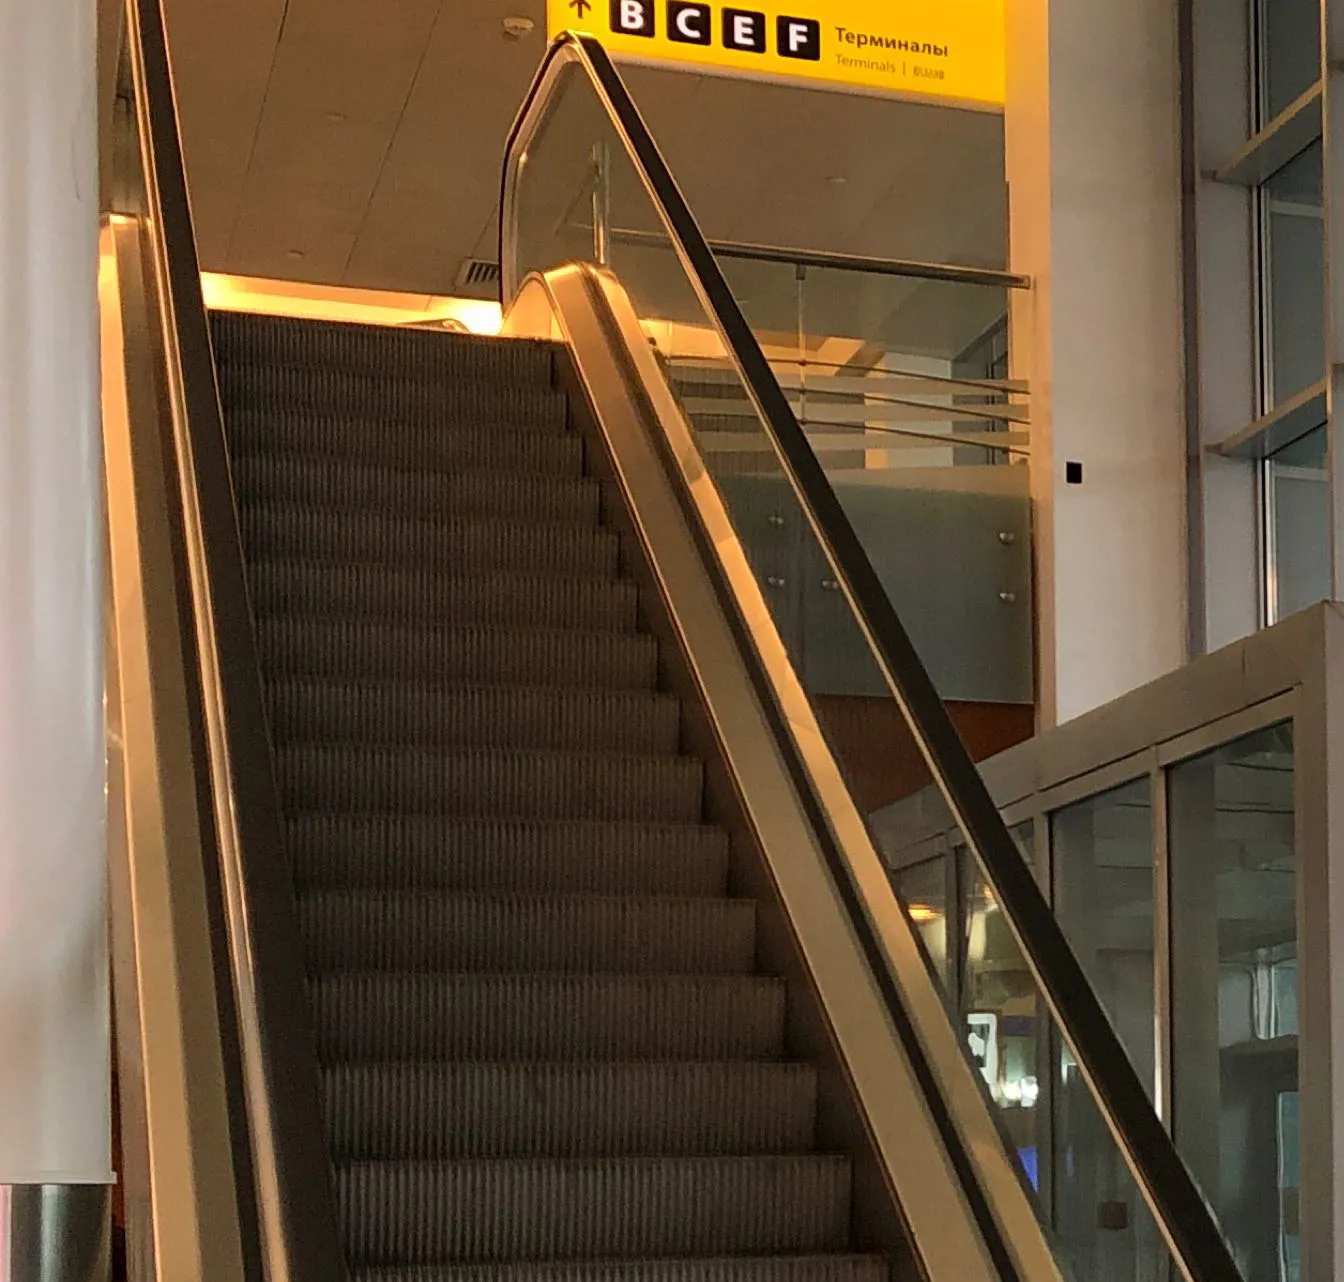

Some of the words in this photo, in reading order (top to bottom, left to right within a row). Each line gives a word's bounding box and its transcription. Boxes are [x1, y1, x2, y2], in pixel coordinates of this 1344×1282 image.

[620, 0, 644, 30] B
[676, 8, 701, 39] C
[734, 15, 755, 46] E
[789, 23, 808, 52] F
[834, 26, 949, 57] Терминалы
[835, 53, 896, 73] Terminals
